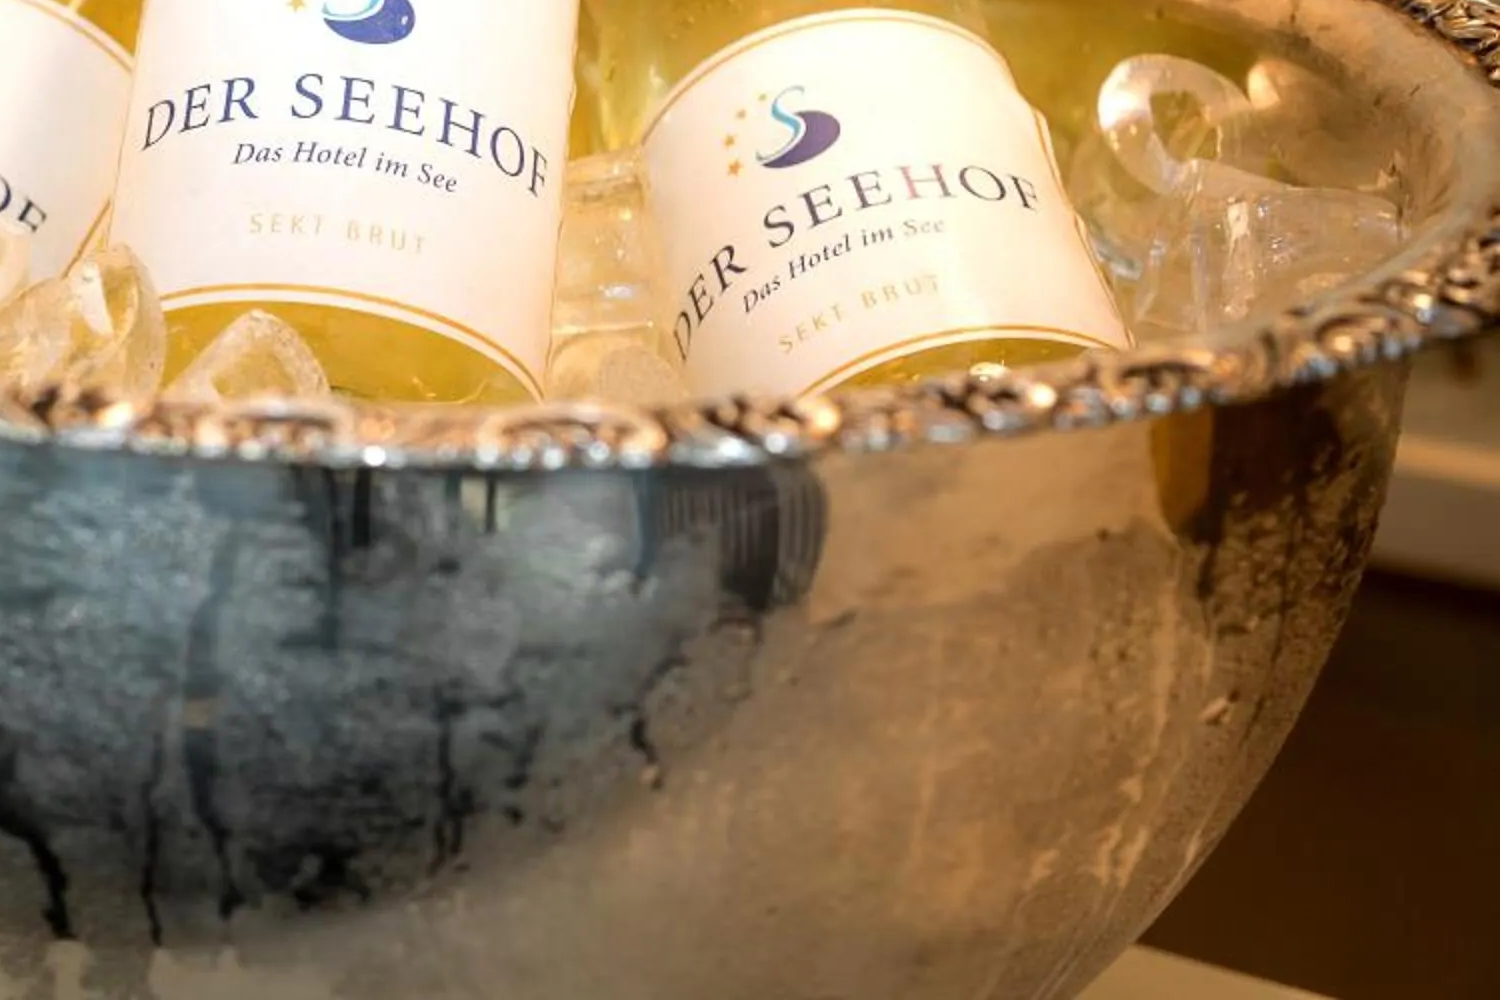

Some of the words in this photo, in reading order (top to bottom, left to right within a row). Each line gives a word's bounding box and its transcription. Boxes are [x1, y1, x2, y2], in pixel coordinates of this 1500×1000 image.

[141, 76, 258, 151] DER
[290, 73, 548, 198] SEEHOF
[233, 142, 283, 165] Das
[292, 140, 368, 170] Hotel
[374, 151, 409, 178] im
[416, 162, 458, 193] See
[249, 212, 325, 236] SEKT
[346, 219, 426, 255] BRUT
[672, 244, 748, 363] DER
[762, 162, 1040, 249] SEEHOF
[742, 274, 782, 314] Das
[787, 232, 852, 281] Hotel
[860, 225, 894, 249] im
[902, 217, 947, 239] See
[778, 303, 845, 354] SEKT
[860, 273, 940, 311] BRUT
